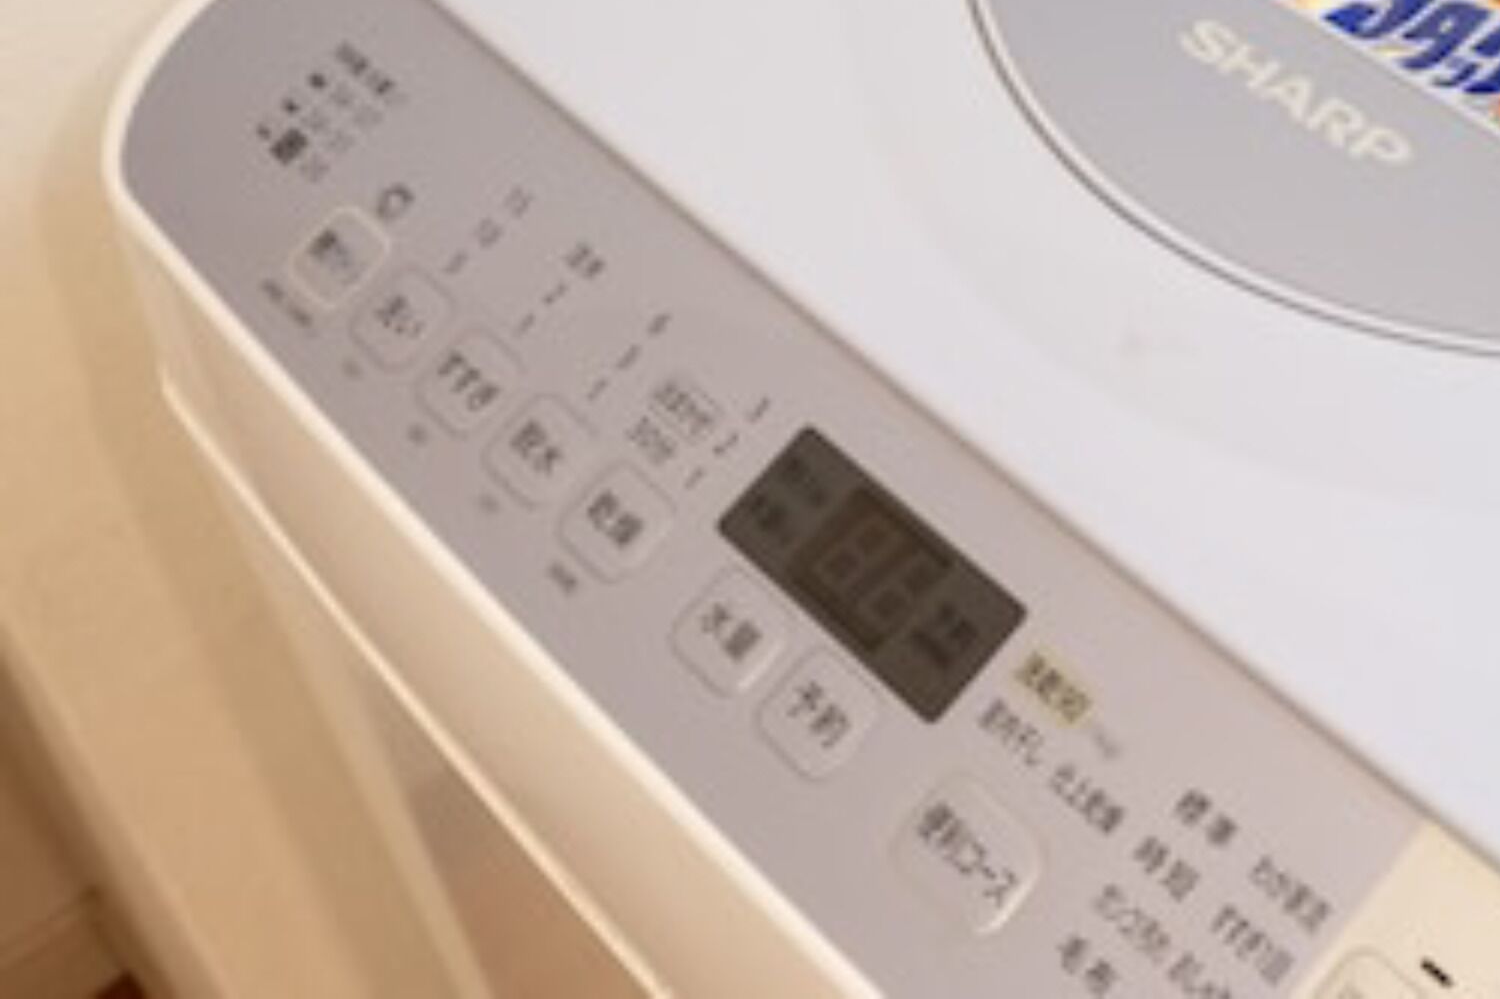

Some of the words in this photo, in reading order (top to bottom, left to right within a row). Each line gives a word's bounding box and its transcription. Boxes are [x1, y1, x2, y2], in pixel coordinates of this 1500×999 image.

[1179, 20, 1412, 163] SHARP
[438, 352, 500, 414] すすぎ
[509, 420, 563, 474] 脱水
[587, 489, 644, 549] 乾燥
[701, 602, 762, 662] 水量
[787, 680, 850, 749] 予約
[1173, 788, 1238, 847] 標準
[916, 802, 1021, 899] 便利コース
[1134, 836, 1199, 902] 時短
